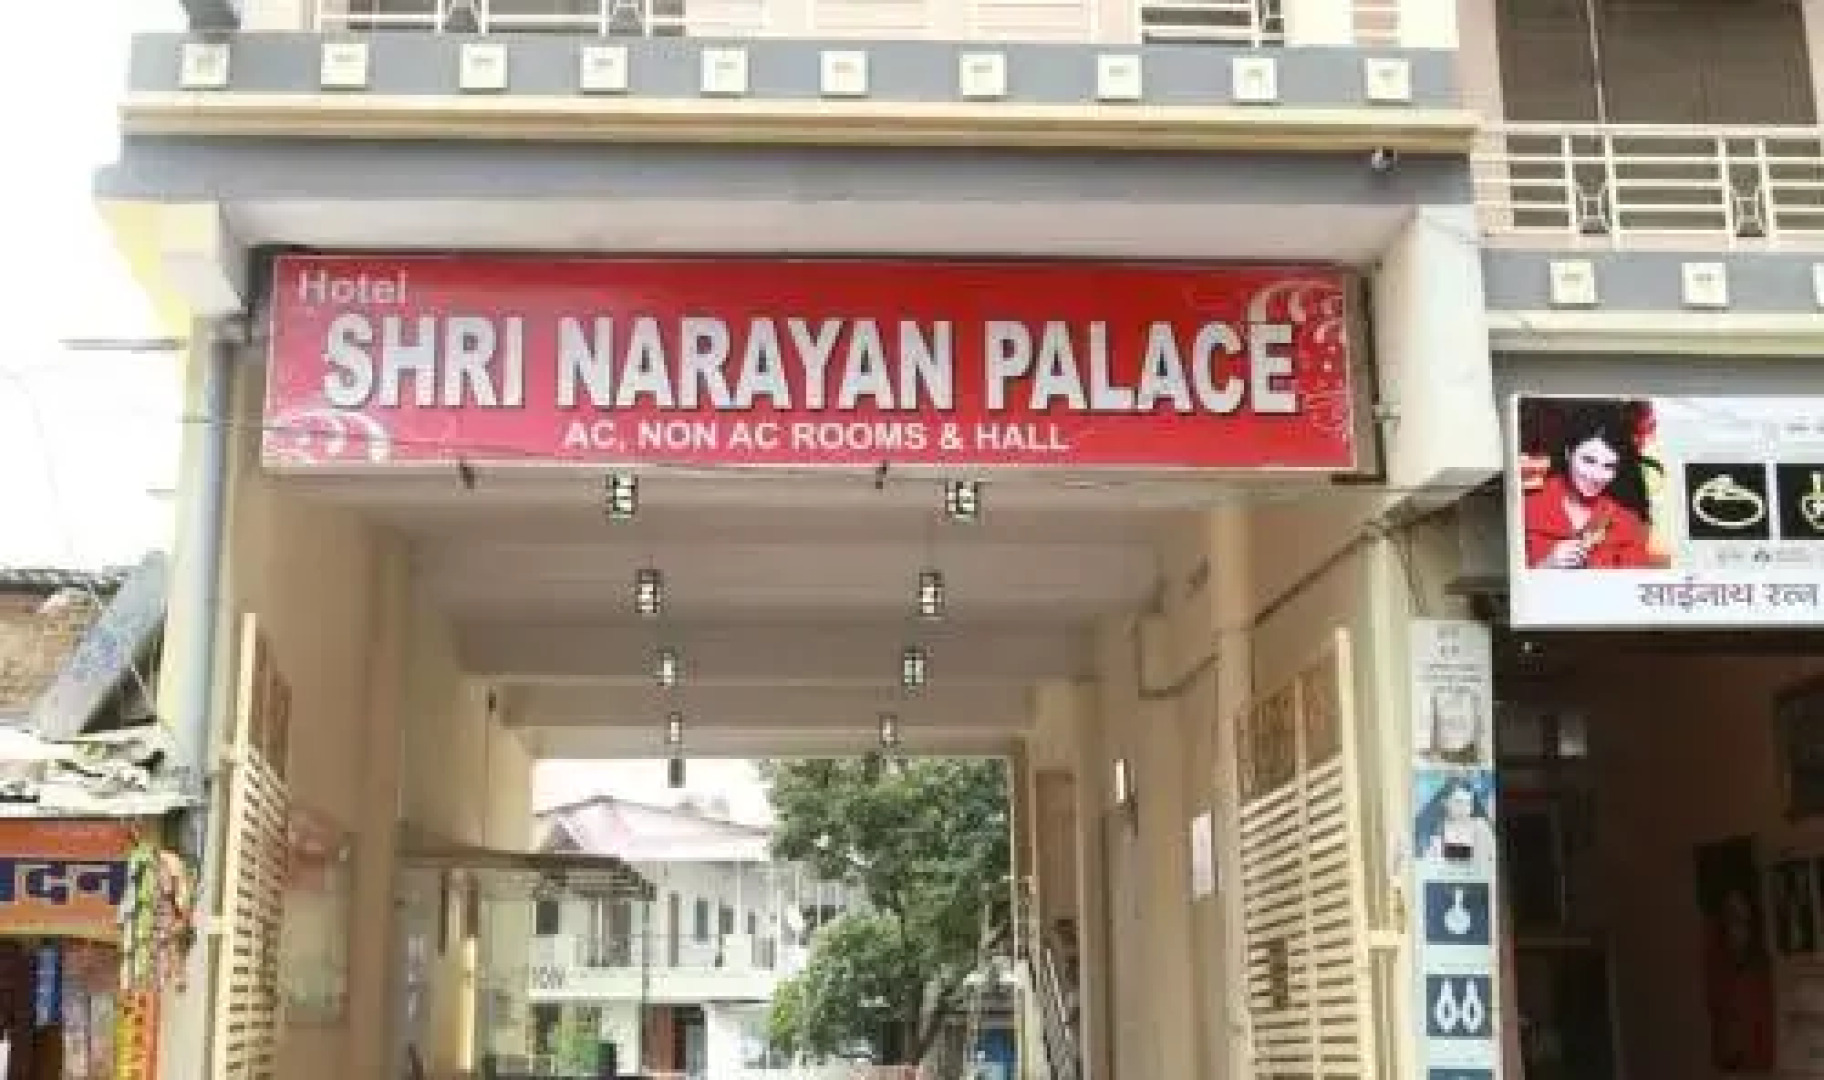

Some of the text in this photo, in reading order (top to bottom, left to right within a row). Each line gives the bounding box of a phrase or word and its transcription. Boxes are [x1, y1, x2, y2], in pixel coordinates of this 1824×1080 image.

[299, 270, 408, 304] Hotel
[322, 313, 1298, 414] SHRI NARAYAN PALACE
[563, 422, 1070, 453] AC, NON AC ROOMS & HALL
